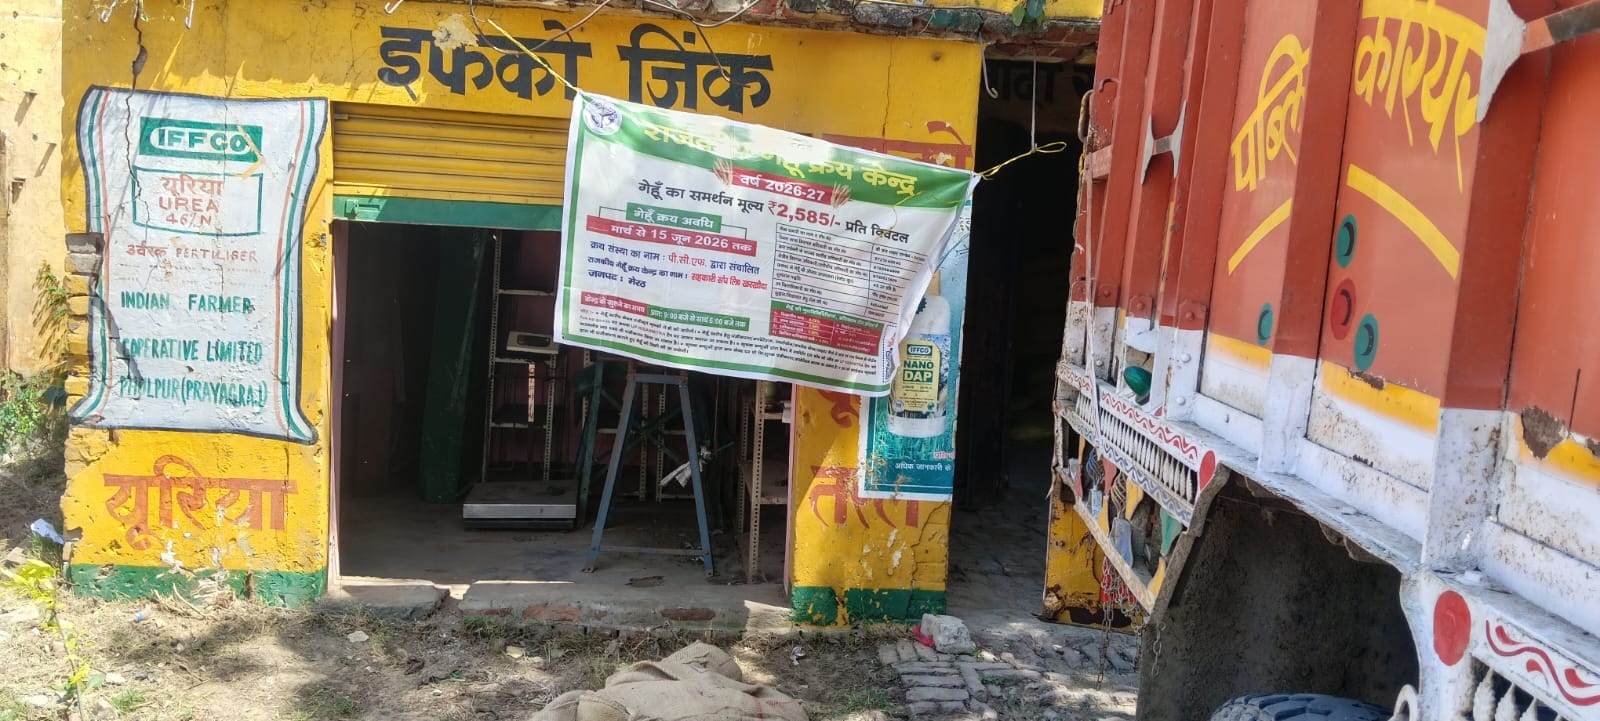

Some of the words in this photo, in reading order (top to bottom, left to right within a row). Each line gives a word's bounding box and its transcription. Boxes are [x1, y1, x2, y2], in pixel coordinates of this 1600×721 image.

[377, 19, 592, 101] इफको
[616, 22, 773, 113] जिंक
[157, 127, 247, 151] IFFCO
[160, 175, 223, 197] यूरिया
[739, 174, 762, 187] वर्ष
[765, 179, 826, 201] 2026-27
[862, 163, 917, 196] केन्द्र
[159, 197, 219, 212] UREA
[638, 178, 663, 201] गेहूँ
[665, 185, 685, 199] का
[689, 189, 733, 207] समर्थन
[737, 197, 764, 214] मूल्य
[767, 200, 841, 230] ₹2,585/-
[844, 219, 867, 236] प्रति
[633, 207, 655, 225] गेहूँ
[657, 212, 678, 225] क्रय
[681, 215, 715, 229] अवधि
[610, 223, 634, 236] मार्च
[635, 226, 647, 237] से
[650, 229, 667, 240] 15
[670, 233, 693, 246] जून
[694, 235, 729, 250] 2026
[731, 242, 753, 253] तक
[590, 240, 605, 252] क्रय
[630, 248, 641, 259] का
[643, 250, 660, 262] नाम
[658, 269, 669, 278] का
[121, 290, 170, 310] INDIAN
[206, 340, 264, 365] LIMITED
[909, 346, 929, 354] IFFCO
[903, 360, 934, 370] NANO
[903, 370, 933, 382] DAP
[103, 454, 298, 551] यूरिया
